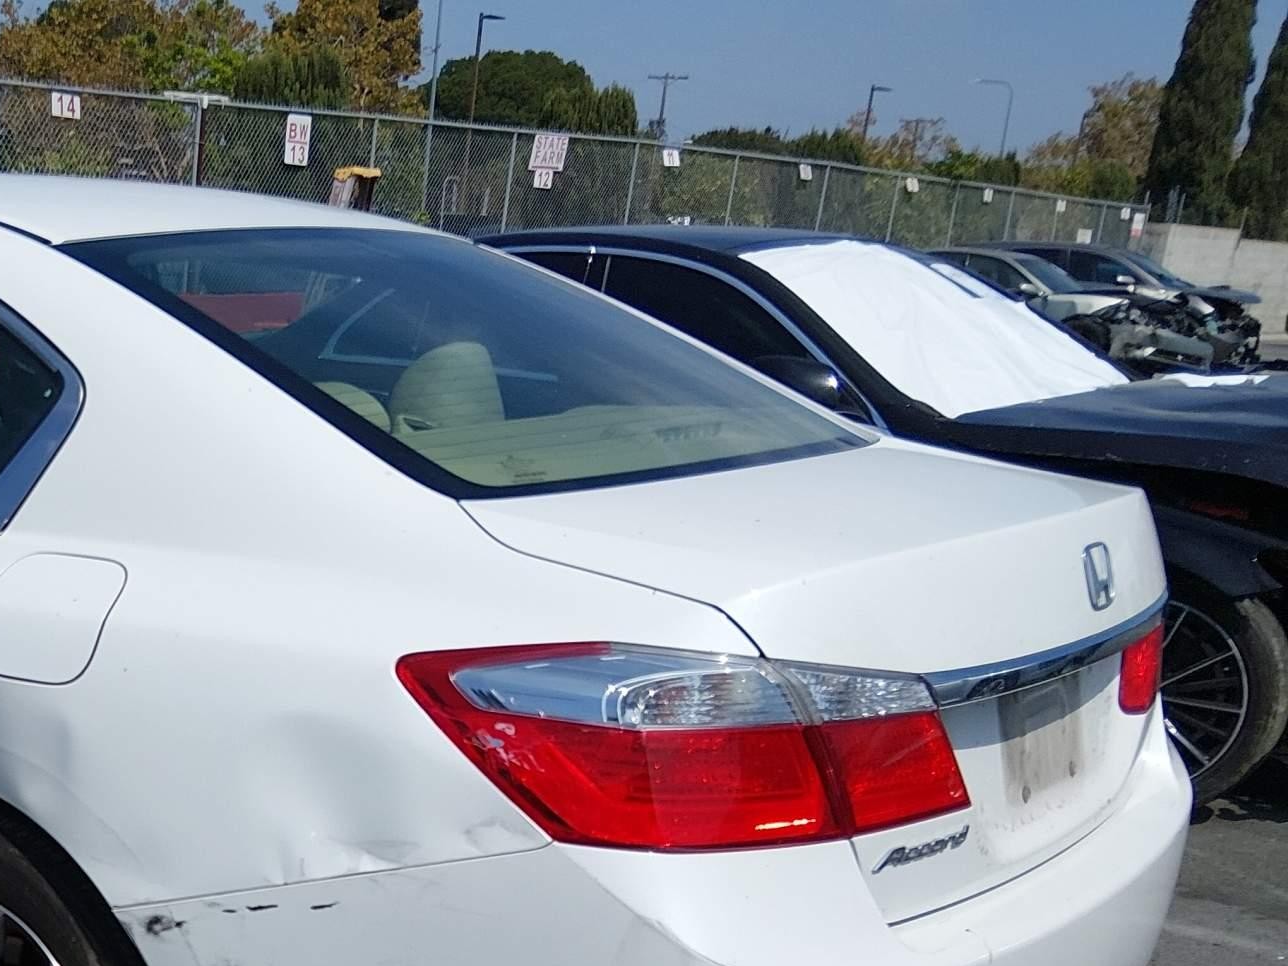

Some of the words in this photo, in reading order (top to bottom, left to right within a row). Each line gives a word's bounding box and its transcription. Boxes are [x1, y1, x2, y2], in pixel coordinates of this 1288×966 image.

[57, 95, 76, 118] 14
[288, 122, 309, 141] BW
[536, 136, 567, 151] STATE
[290, 144, 306, 165] 13
[534, 150, 563, 165] FARM
[538, 171, 551, 187] 12
[871, 823, 970, 875] Accord
